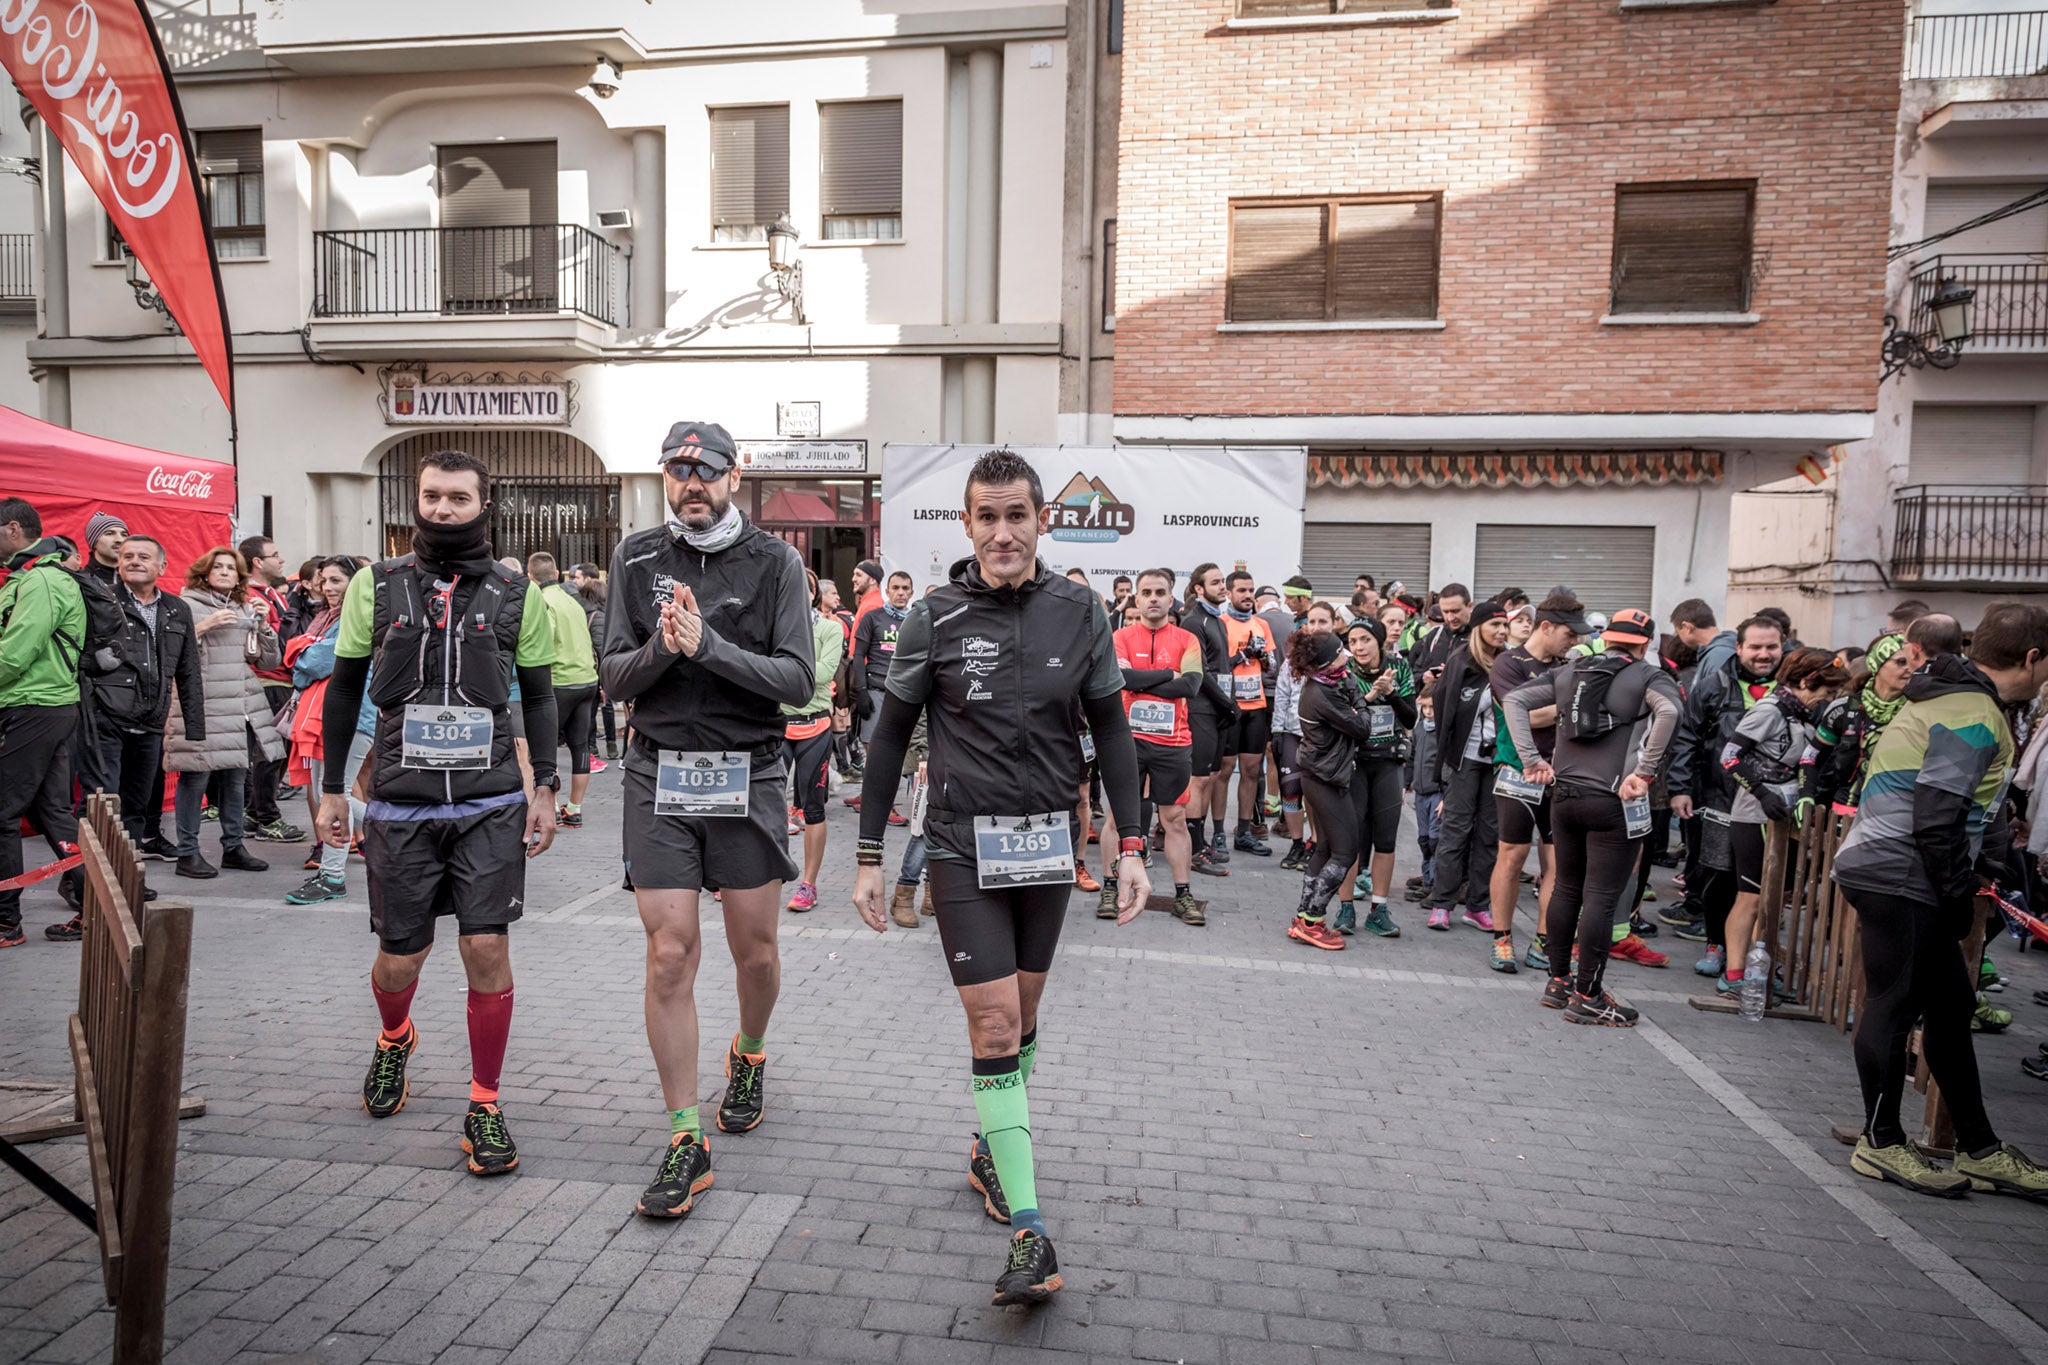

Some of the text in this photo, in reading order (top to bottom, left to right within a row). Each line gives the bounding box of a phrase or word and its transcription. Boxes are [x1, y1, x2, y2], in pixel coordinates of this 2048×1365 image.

[417, 391, 559, 416] AYUNTAMIENTO
[785, 451, 802, 461] DEL
[806, 451, 850, 461] JUBILADO
[1162, 514, 1260, 528] LASPROVINCIAS
[1055, 531, 1115, 540] MONTANEJOS
[1090, 568, 1140, 577] LASPROVINCIAS
[1139, 710, 1165, 720] 1370
[421, 724, 473, 741] 1304
[677, 770, 729, 787] 1033
[999, 833, 1051, 854] 1269
